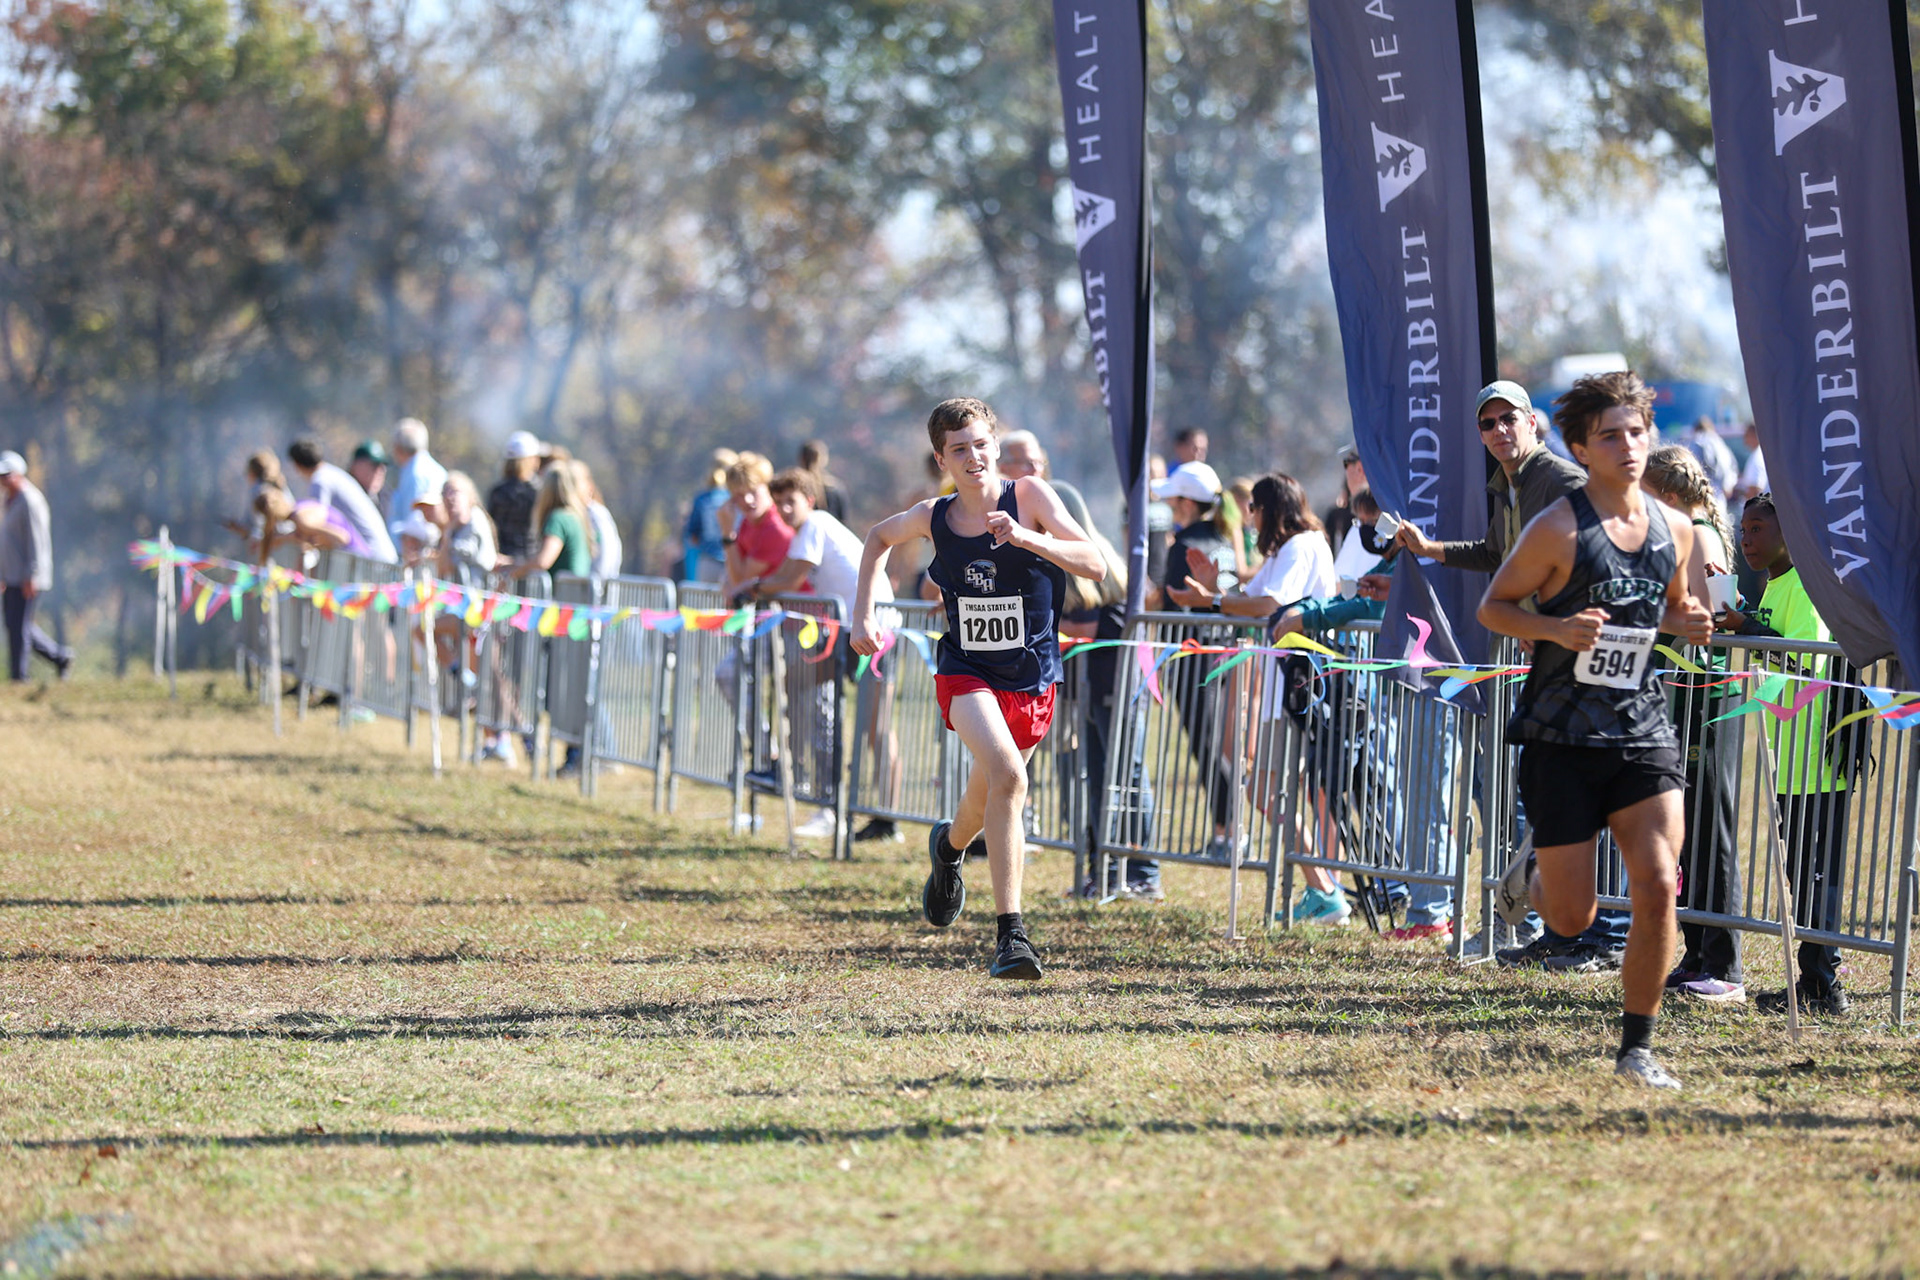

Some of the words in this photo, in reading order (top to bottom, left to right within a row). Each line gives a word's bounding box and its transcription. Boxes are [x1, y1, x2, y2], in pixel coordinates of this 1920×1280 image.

[1073, 10, 1102, 164] HEALT
[1800, 171, 1871, 585] VANDERBILT
[1401, 225, 1442, 567] ANDERBILT
[966, 567, 994, 592] SBA
[965, 603, 986, 612] TMSAA
[986, 603, 1006, 612] STATE
[1007, 602, 1017, 611] XC
[963, 616, 1019, 643] 1200
[1588, 647, 1637, 679] 594
